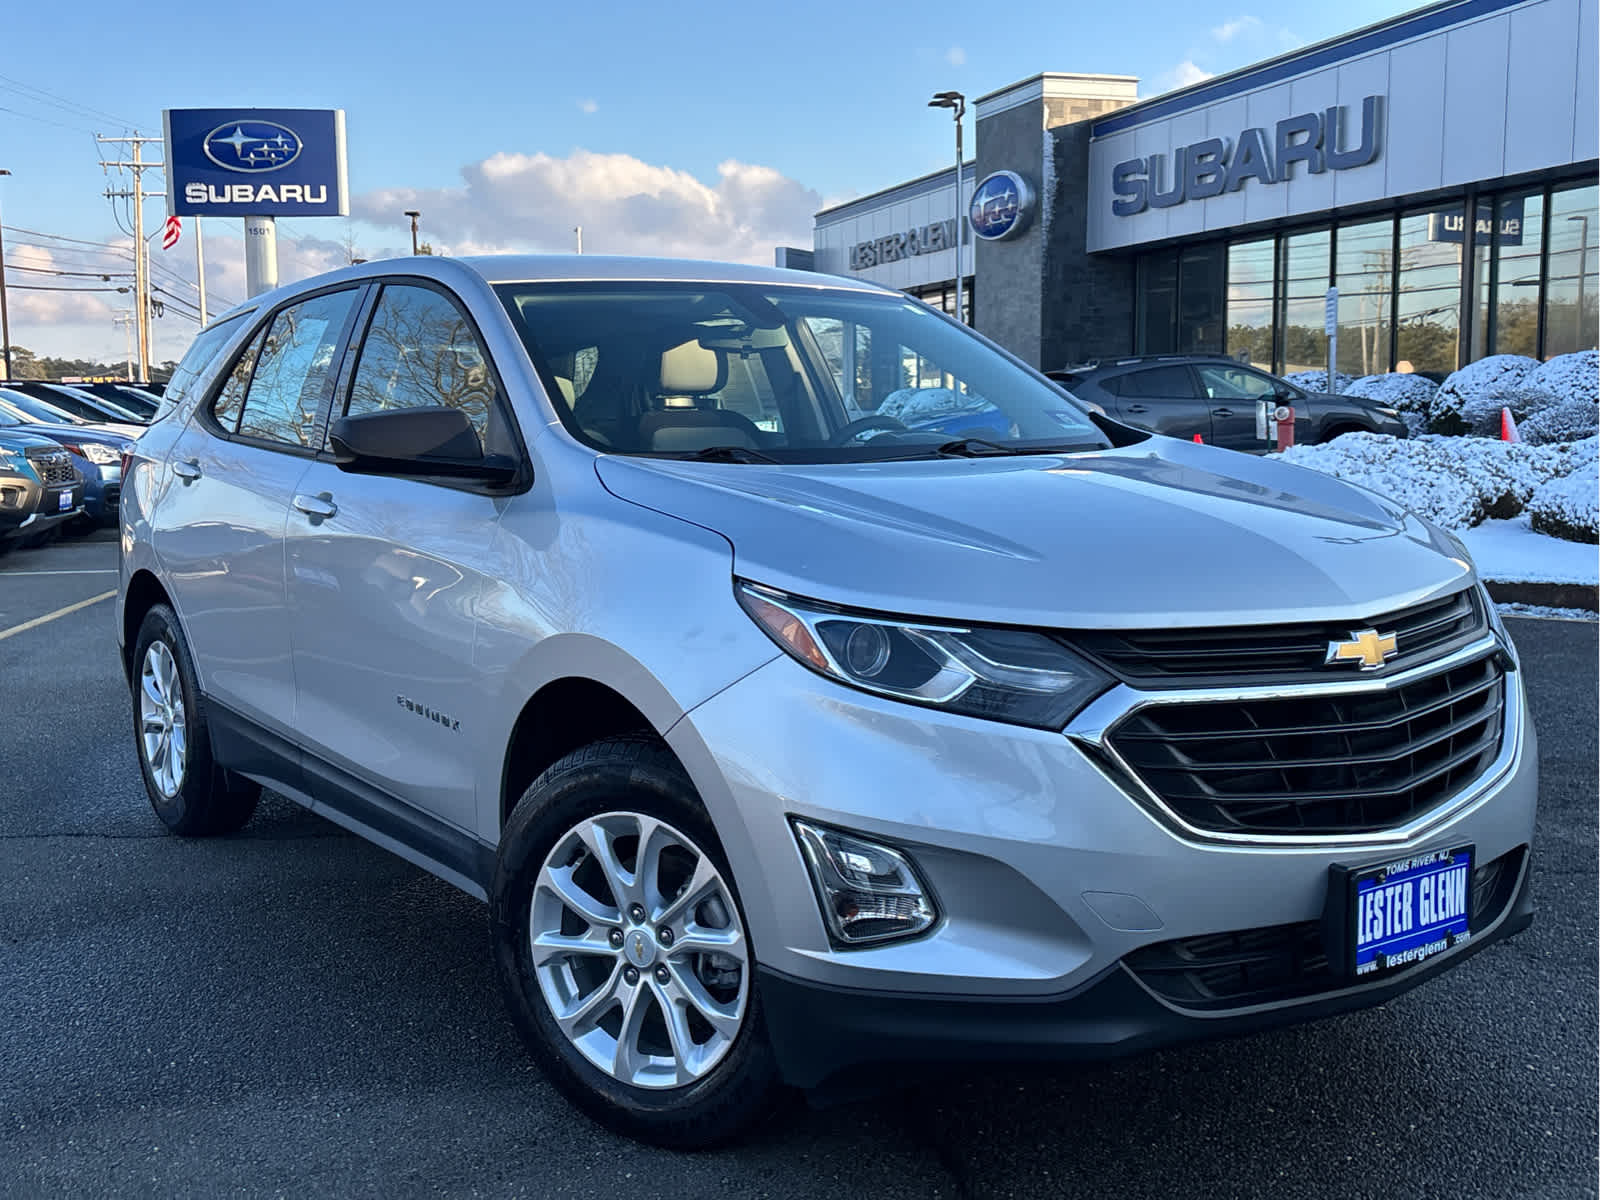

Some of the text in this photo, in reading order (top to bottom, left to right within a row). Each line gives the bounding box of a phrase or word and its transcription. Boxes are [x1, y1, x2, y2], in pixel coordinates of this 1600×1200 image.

[1112, 96, 1381, 216] SUBARU
[185, 183, 327, 203] SUBARU
[849, 232, 904, 271] LESTER
[1386, 860, 1410, 876] TOMS
[1439, 849, 1450, 861] NJ
[1358, 867, 1466, 945] LESTER GLENN
[1386, 941, 1447, 968] lesterglenn
